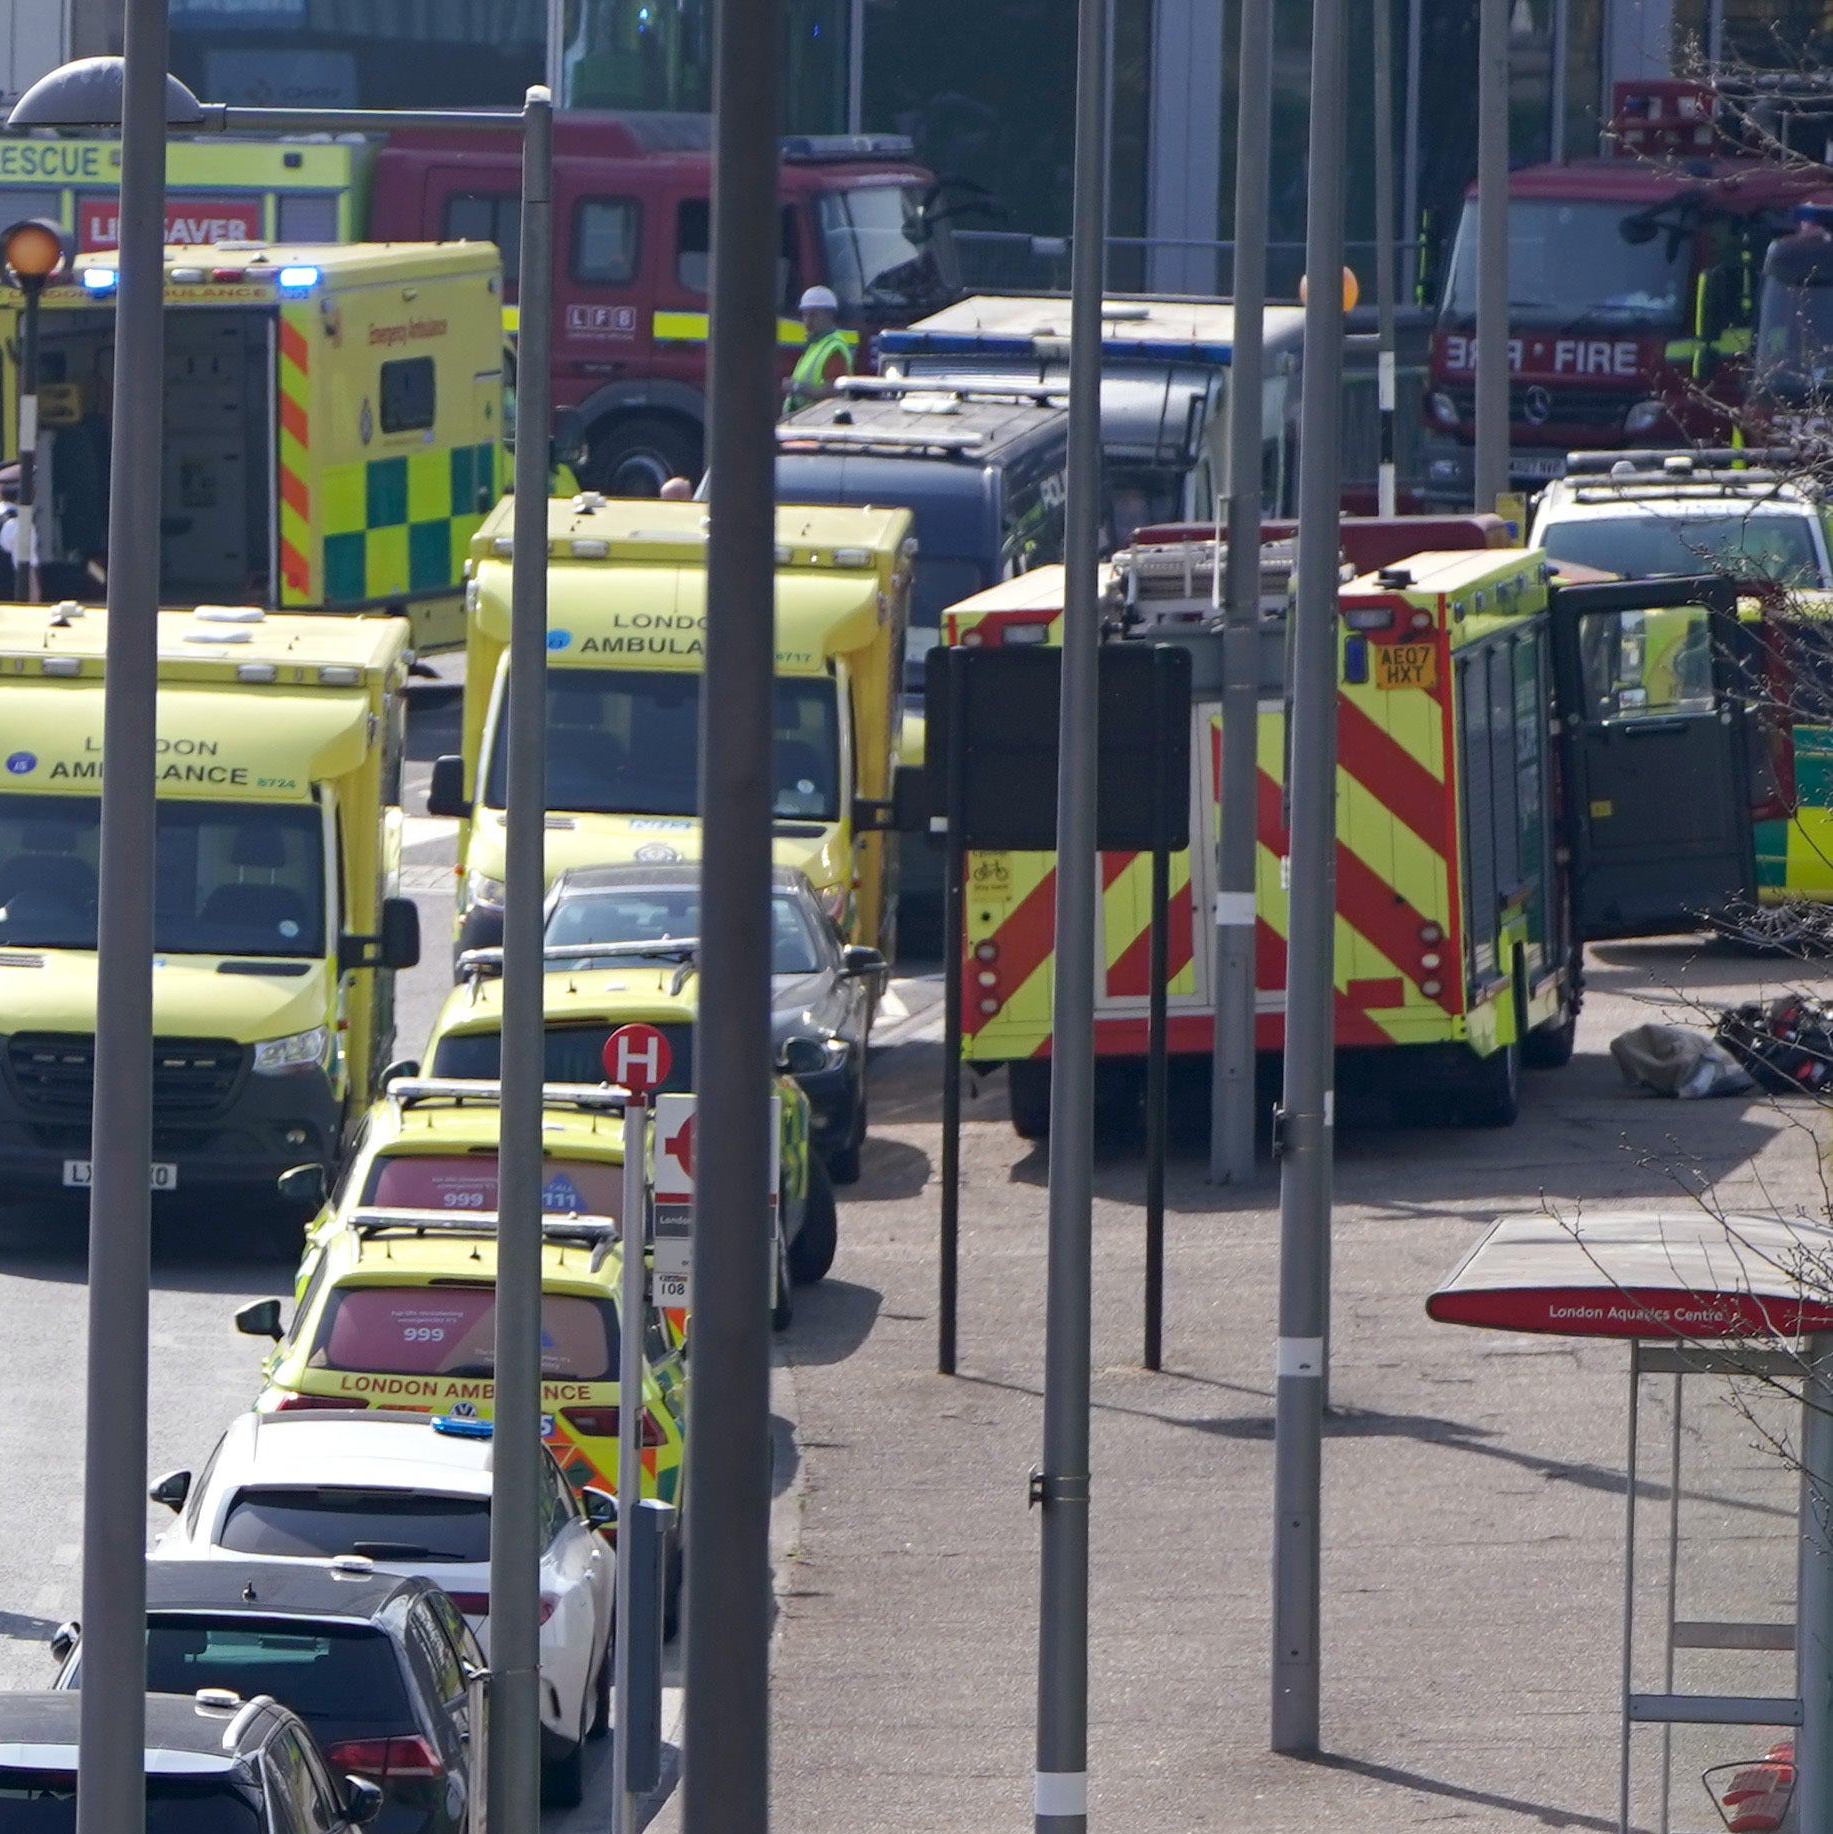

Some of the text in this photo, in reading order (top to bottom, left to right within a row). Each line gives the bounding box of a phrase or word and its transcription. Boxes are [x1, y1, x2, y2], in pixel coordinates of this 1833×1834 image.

[1555, 340, 1638, 376] FIRE
[1381, 646, 1430, 665] AE07
[1387, 665, 1424, 684] HXT
[618, 1036, 658, 1084] H
[443, 1193, 483, 1208] 999
[542, 1193, 576, 1208] 111
[659, 1215, 693, 1227] Londo
[660, 1283, 686, 1296] 108
[1548, 1305, 1723, 1322] London Aquatics Centre
[403, 1327, 445, 1342] 999
[340, 1375, 438, 1396] LONDON
